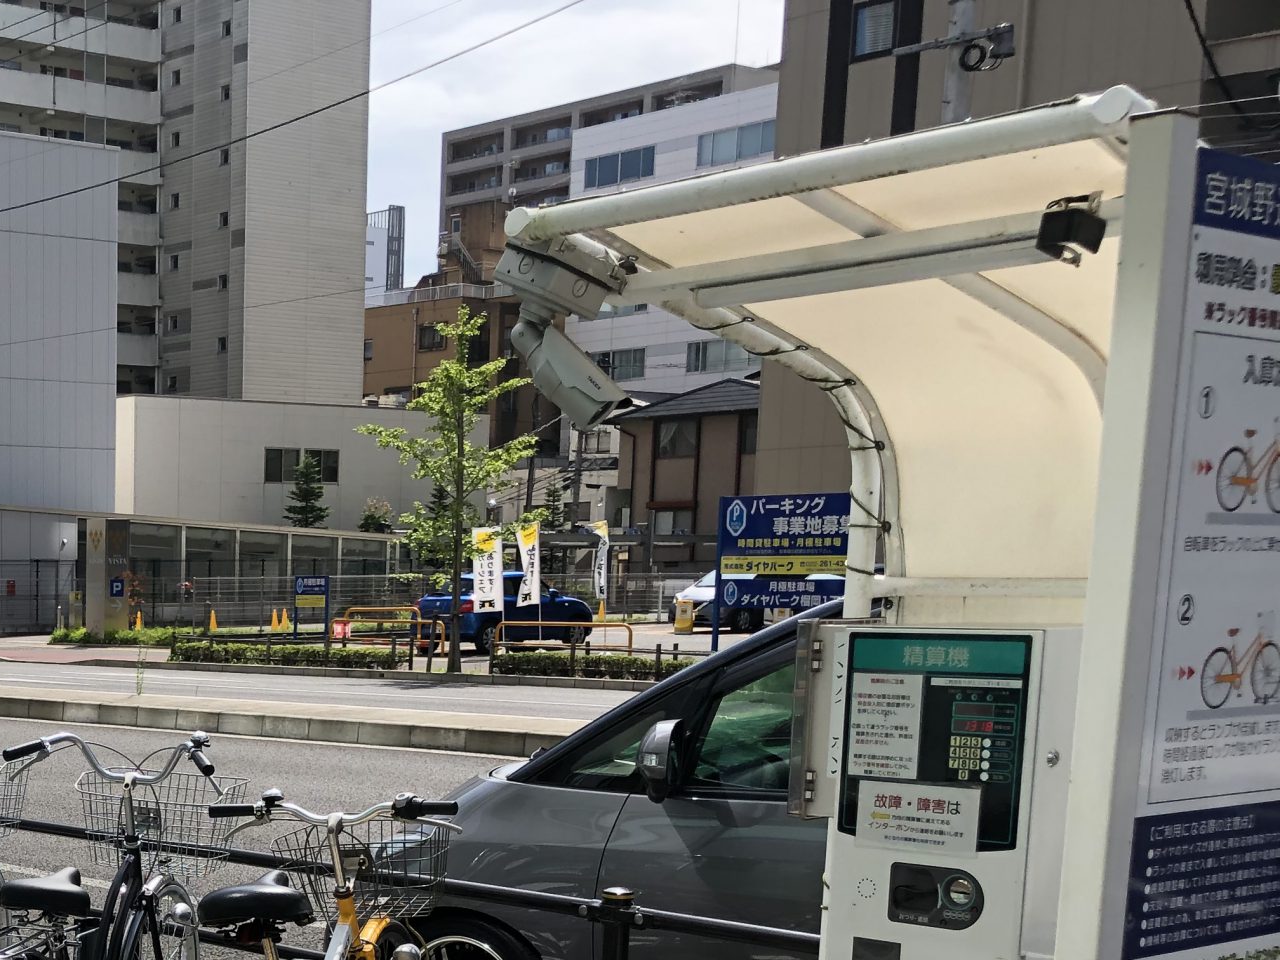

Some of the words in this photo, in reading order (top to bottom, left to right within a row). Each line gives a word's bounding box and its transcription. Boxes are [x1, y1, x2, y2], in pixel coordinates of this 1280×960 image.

[750, 496, 826, 515] パーキング
[772, 516, 850, 536] 事業地募集
[108, 557, 128, 565] VISTA
[745, 561, 794, 572] ダイヤパーク
[113, 582, 122, 594] P
[769, 581, 815, 592] 月極駐車場
[902, 645, 970, 668] 精算機
[952, 736, 959, 746] 1
[962, 737, 969, 746] 2
[972, 738, 980, 747] 3
[951, 748, 958, 757] 4
[961, 748, 968, 757] 5
[972, 748, 979, 758] 6
[950, 759, 957, 768] 7
[961, 759, 967, 769] 8
[971, 760, 978, 769] 9
[960, 770, 967, 780] 0
[873, 793, 961, 815] 故障・障害は
